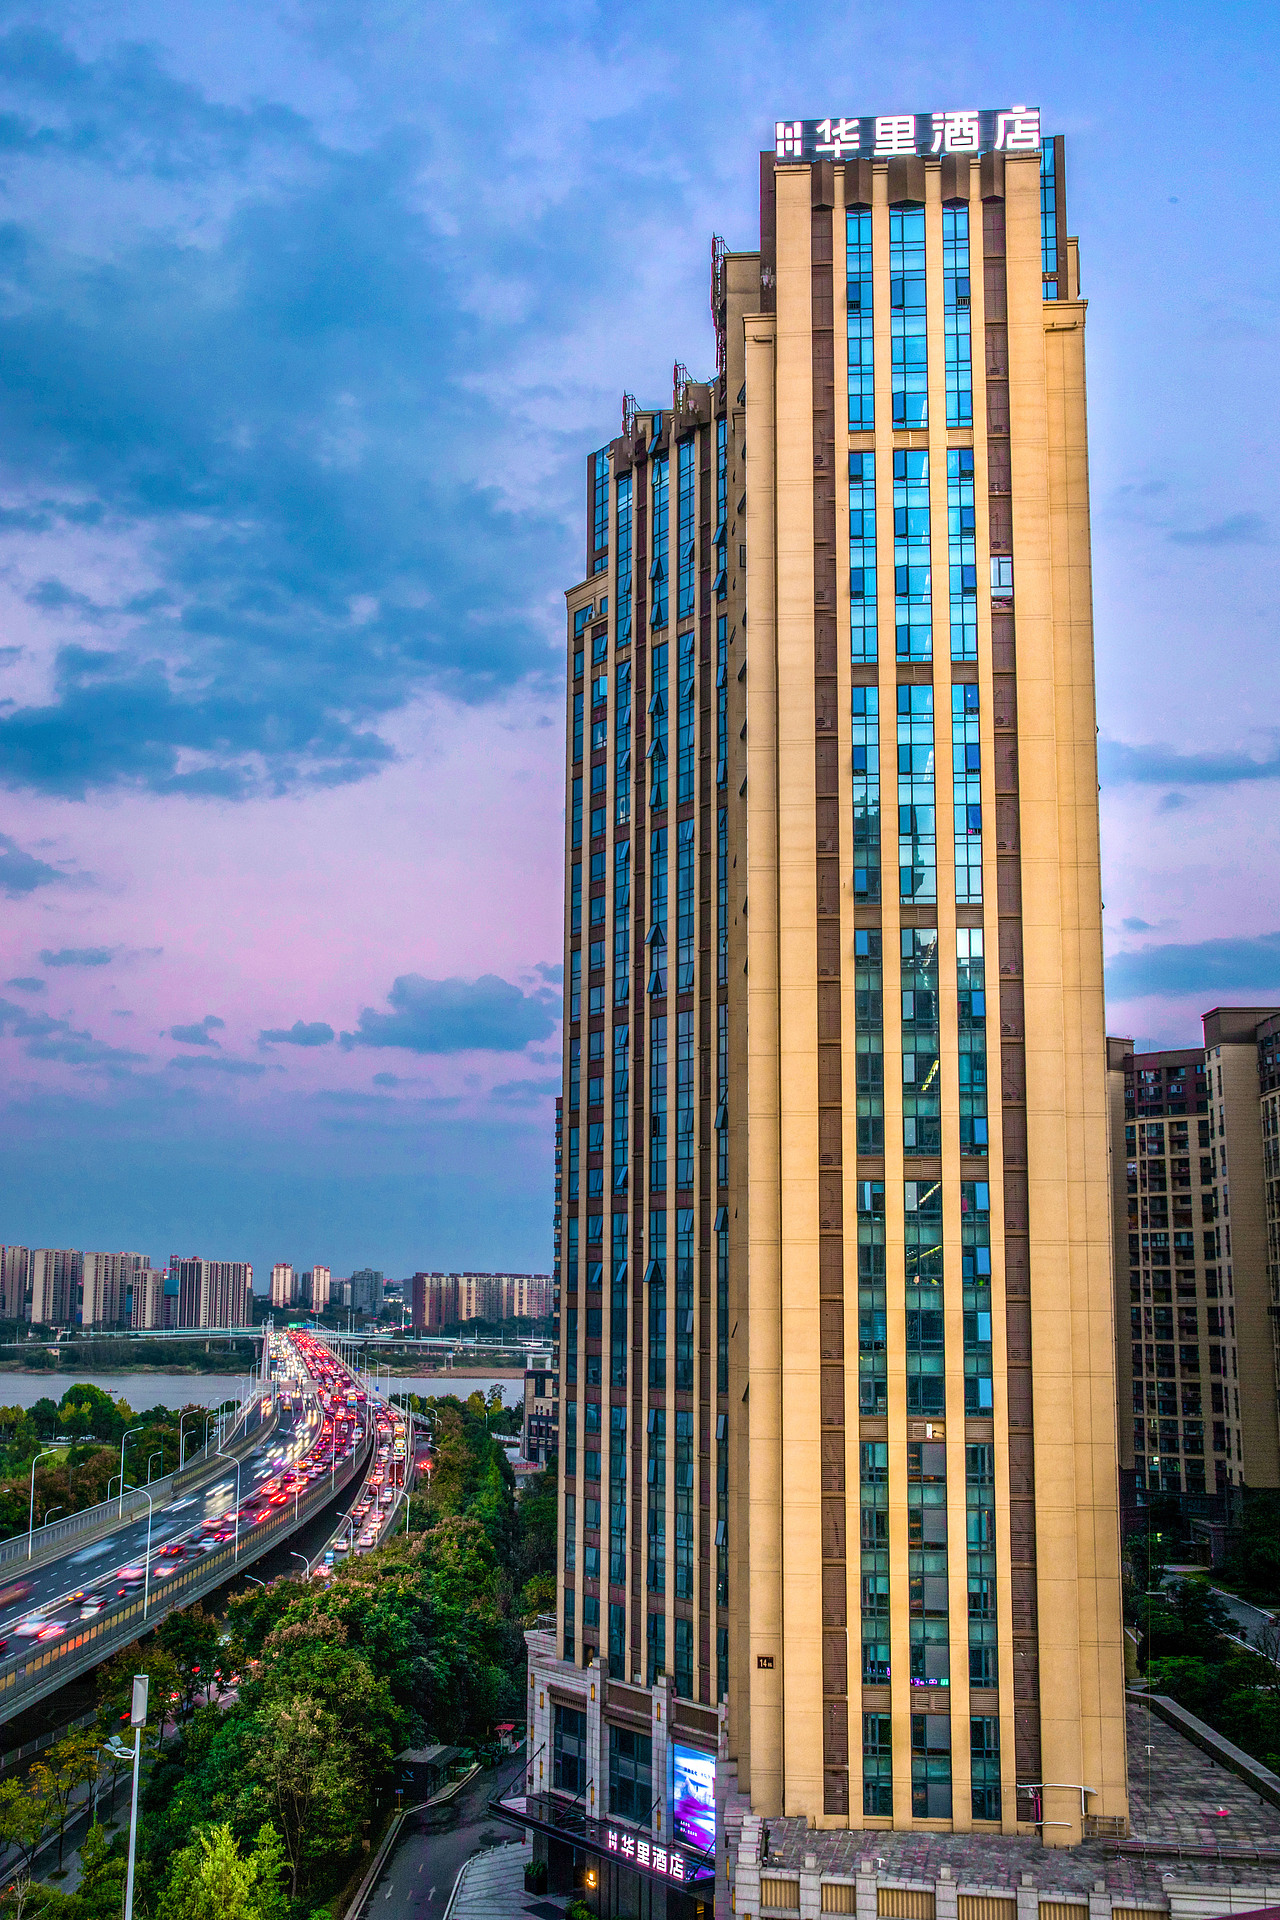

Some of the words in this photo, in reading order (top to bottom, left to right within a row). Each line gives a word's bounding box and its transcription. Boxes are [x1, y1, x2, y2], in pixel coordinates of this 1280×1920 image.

[815, 105, 1040, 158] 华里酒店
[621, 1833, 685, 1880] 华里酒店
